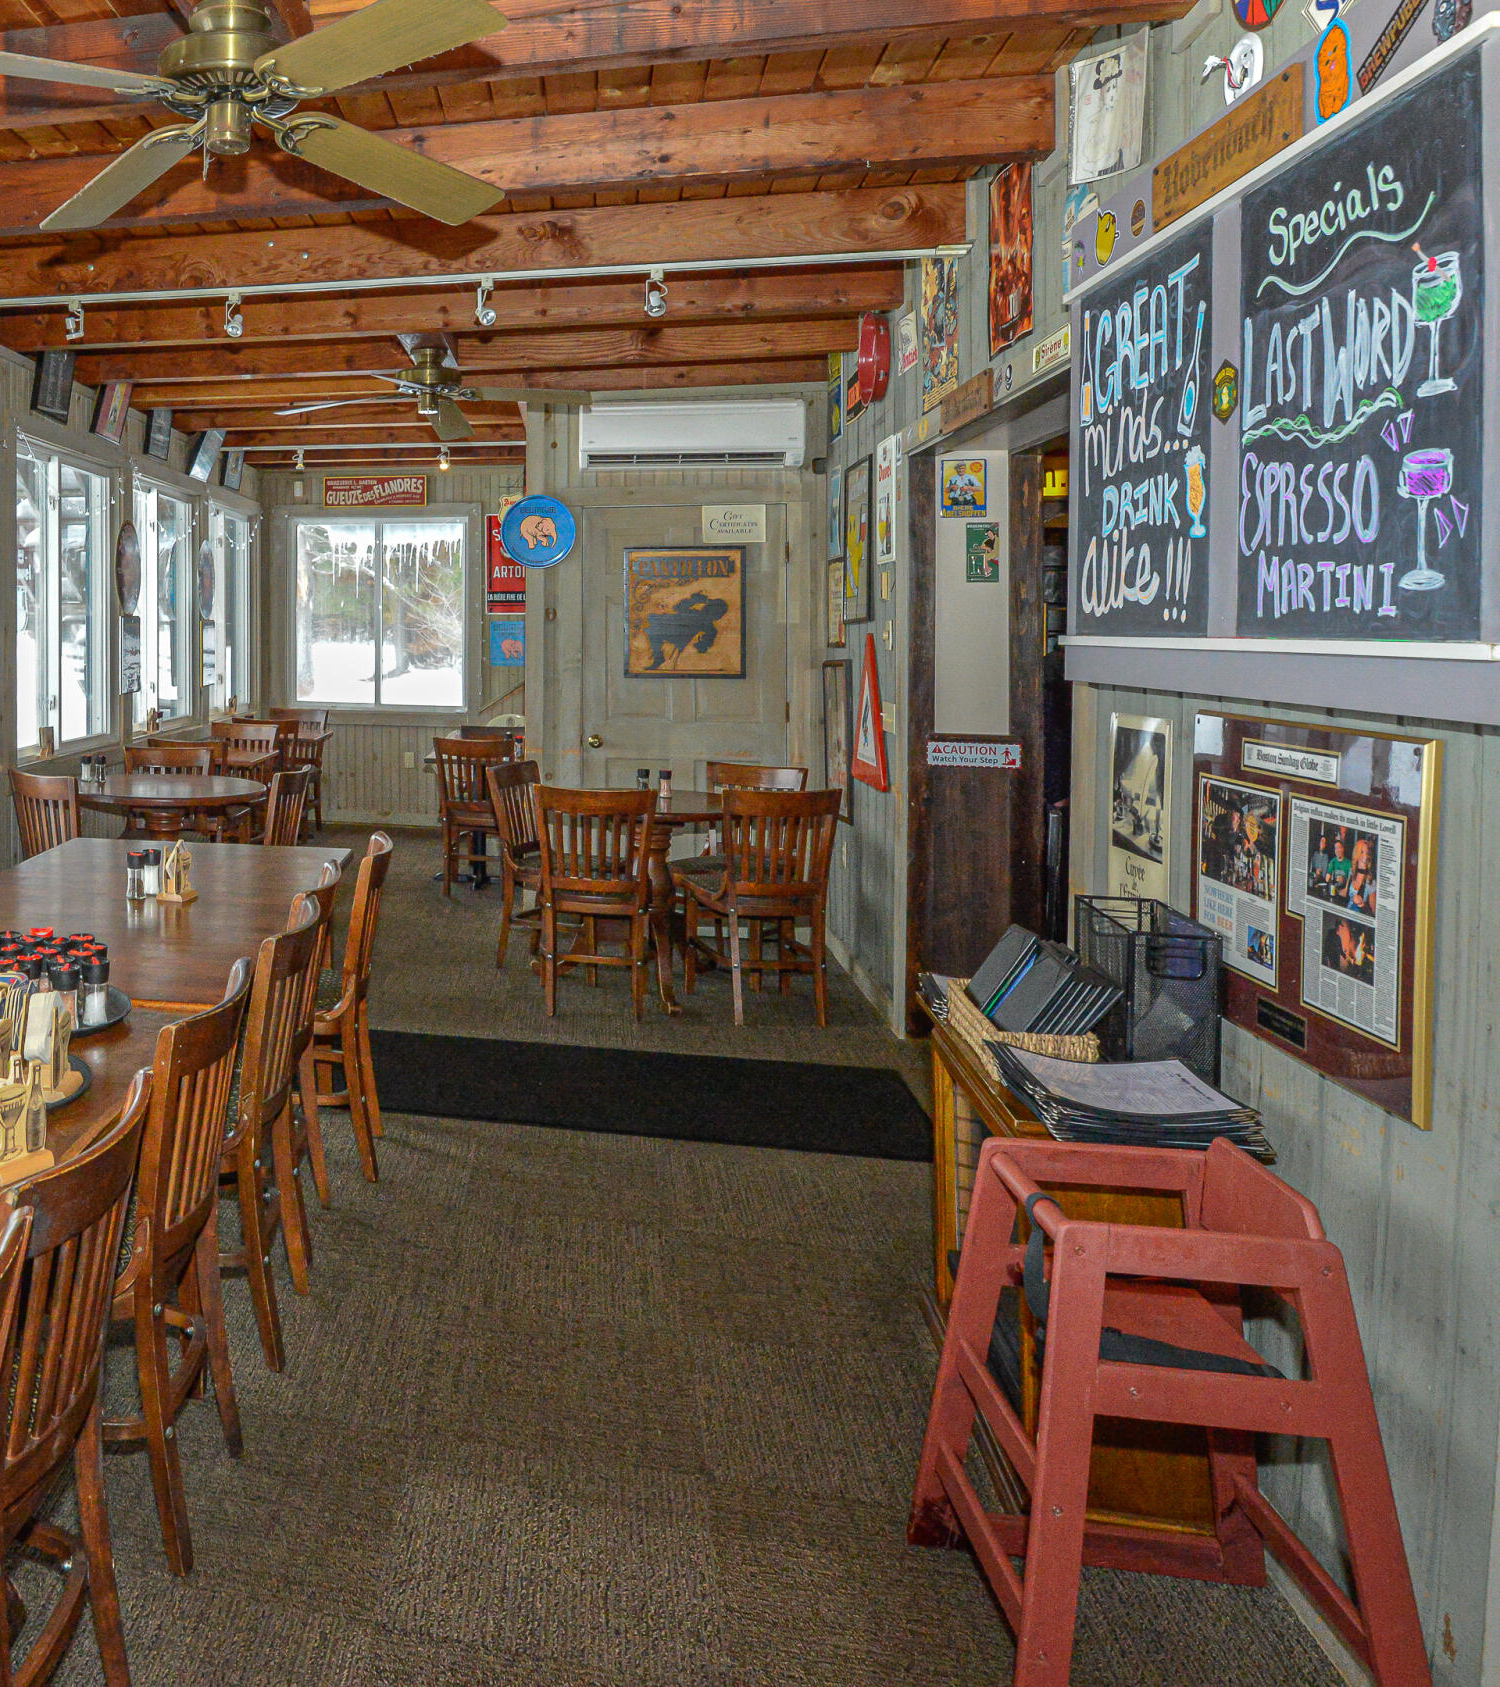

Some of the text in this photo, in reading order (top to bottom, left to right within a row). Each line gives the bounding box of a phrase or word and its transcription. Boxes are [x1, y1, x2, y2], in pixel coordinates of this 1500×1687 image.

[1268, 160, 1404, 266] Specials
[1096, 253, 1199, 413] GREAT
[1242, 287, 1415, 431] LAST WORD
[326, 489, 363, 505] GUEUZE
[363, 491, 376, 502] DES
[373, 478, 423, 499] FLANDRES
[1102, 472, 1181, 539] DRINK
[1239, 451, 1380, 557] ESPRESSO
[493, 565, 526, 579] ARTOI
[639, 560, 729, 577] CANTILLON
[1256, 549, 1397, 618] MARTINI
[942, 744, 997, 756] CAUTION
[980, 757, 999, 765] Step
[1256, 749, 1277, 764] Boston
[1277, 753, 1299, 770] Sunday
[1299, 757, 1319, 771] Globe
[1203, 884, 1234, 905] NOWHERE
[1203, 896, 1234, 919] LIKE HERE
[1203, 909, 1234, 931] FOR BEER
